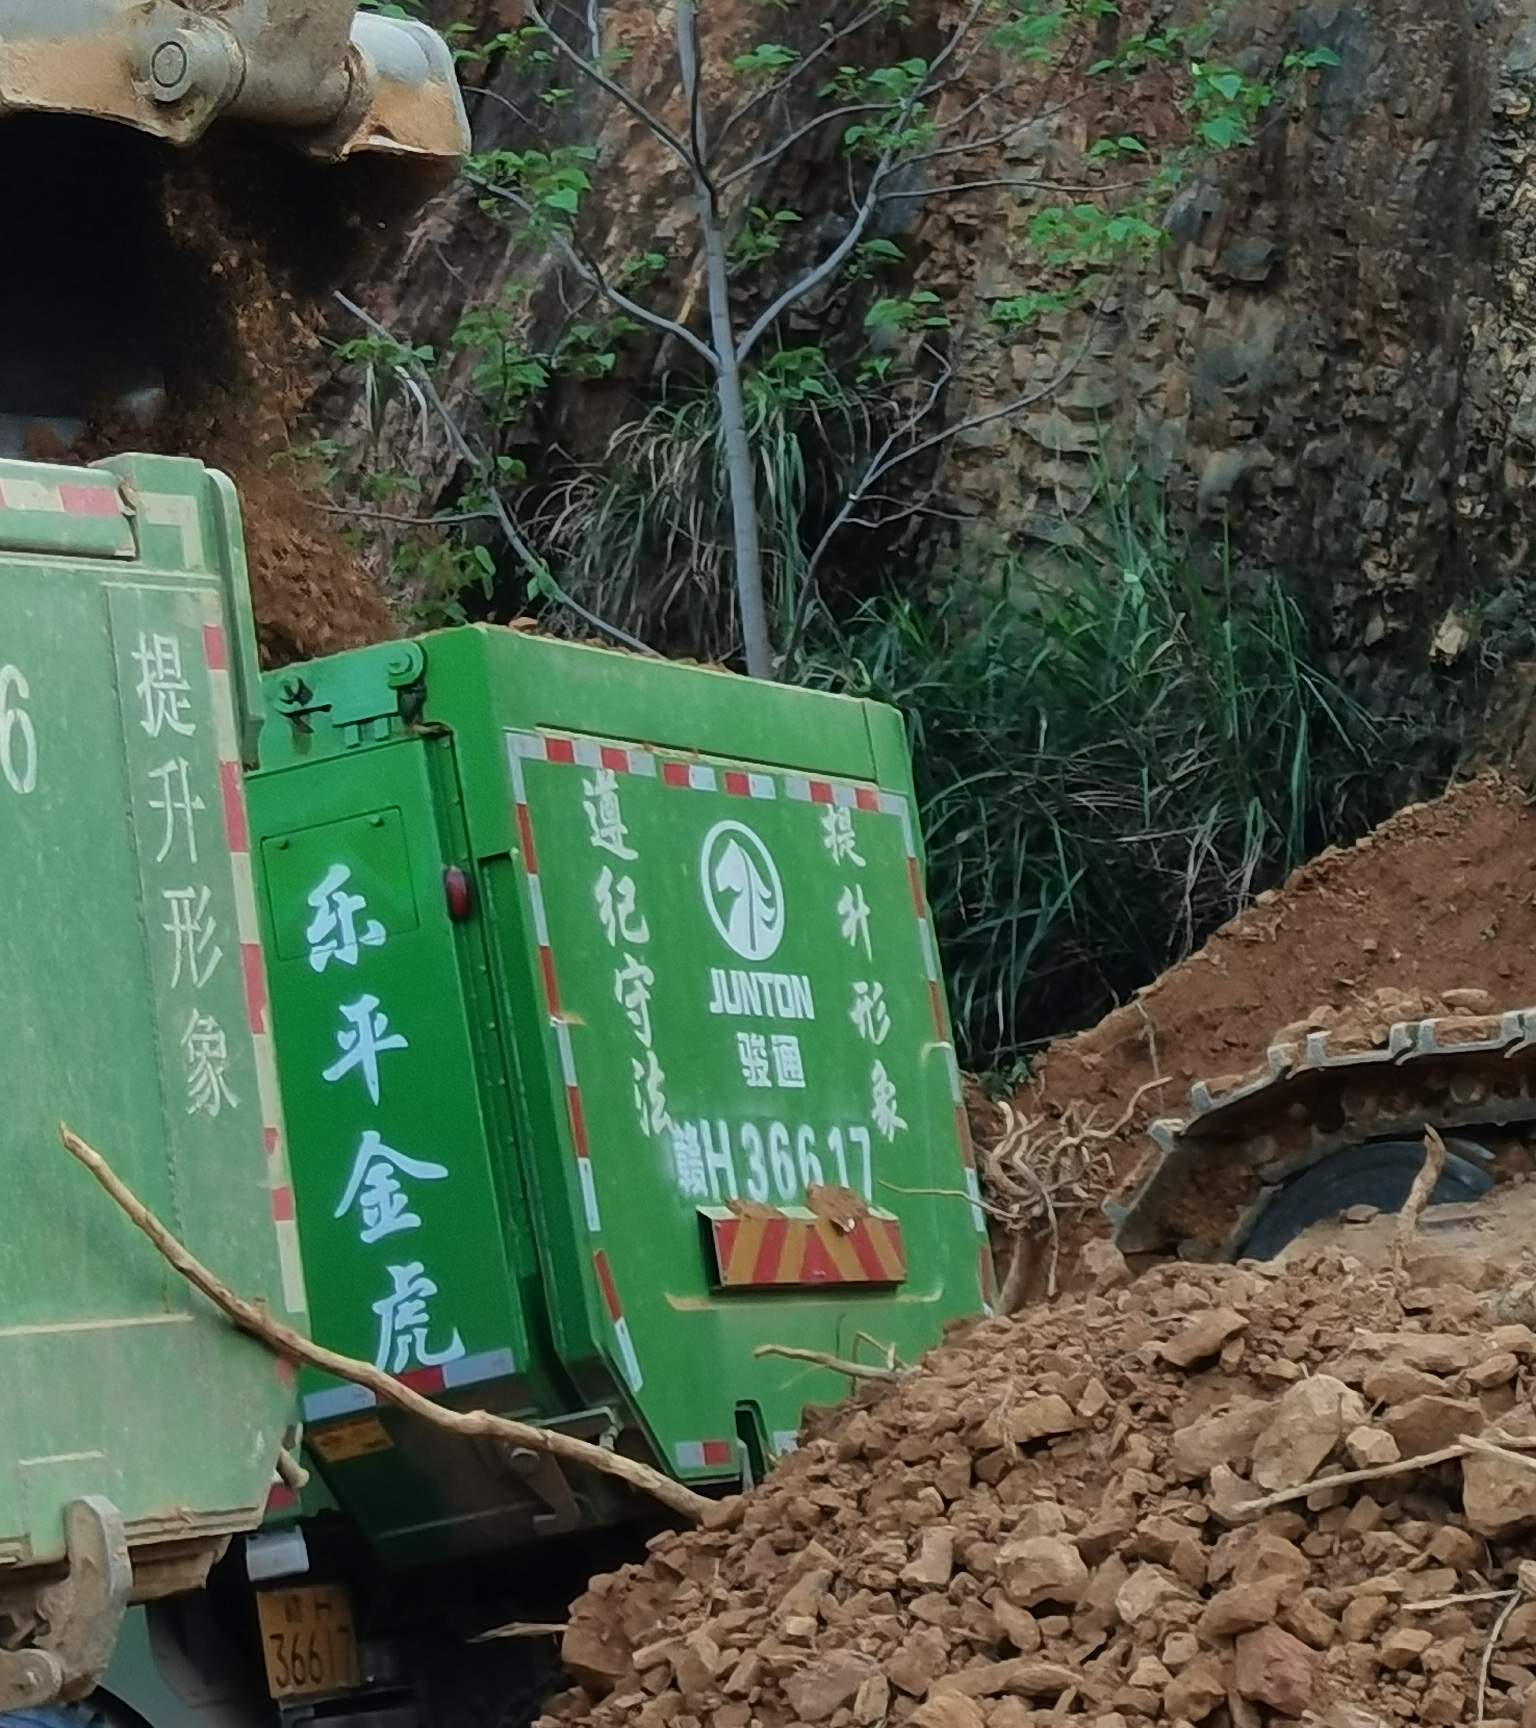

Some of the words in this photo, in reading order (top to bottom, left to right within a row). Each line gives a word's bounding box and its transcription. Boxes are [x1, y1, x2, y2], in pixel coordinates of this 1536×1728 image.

[131, 630, 241, 1118] 提升形象
[582, 768, 674, 1137] 遵纪守法
[710, 968, 815, 1019] JUNTON
[822, 803, 908, 1143] 提升形象
[307, 864, 466, 1374] 乐平金虎
